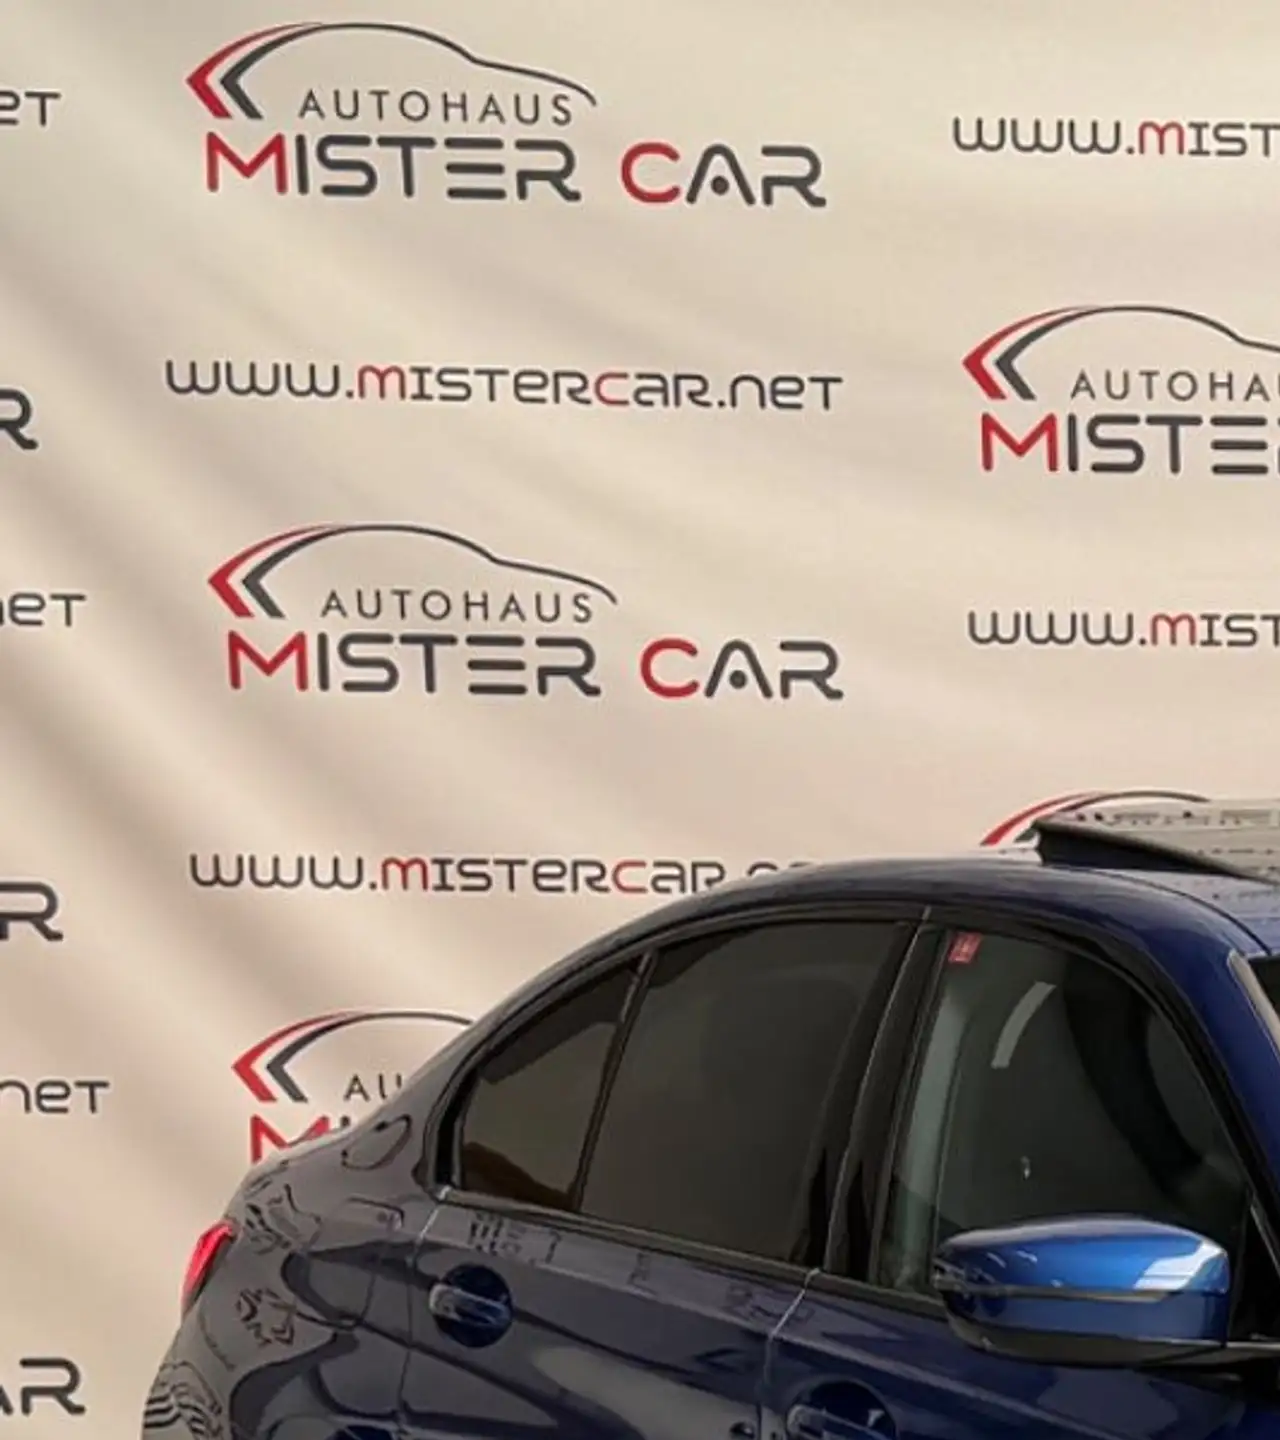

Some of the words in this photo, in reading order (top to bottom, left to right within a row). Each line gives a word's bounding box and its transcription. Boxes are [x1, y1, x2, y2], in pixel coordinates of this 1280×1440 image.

[299, 89, 572, 126] AUTOHAUS
[206, 132, 581, 202] MISTER
[621, 142, 826, 207] CAR
[322, 588, 592, 624] AUTOHAUS
[228, 630, 601, 697] MISTER
[640, 638, 844, 700] CAR
